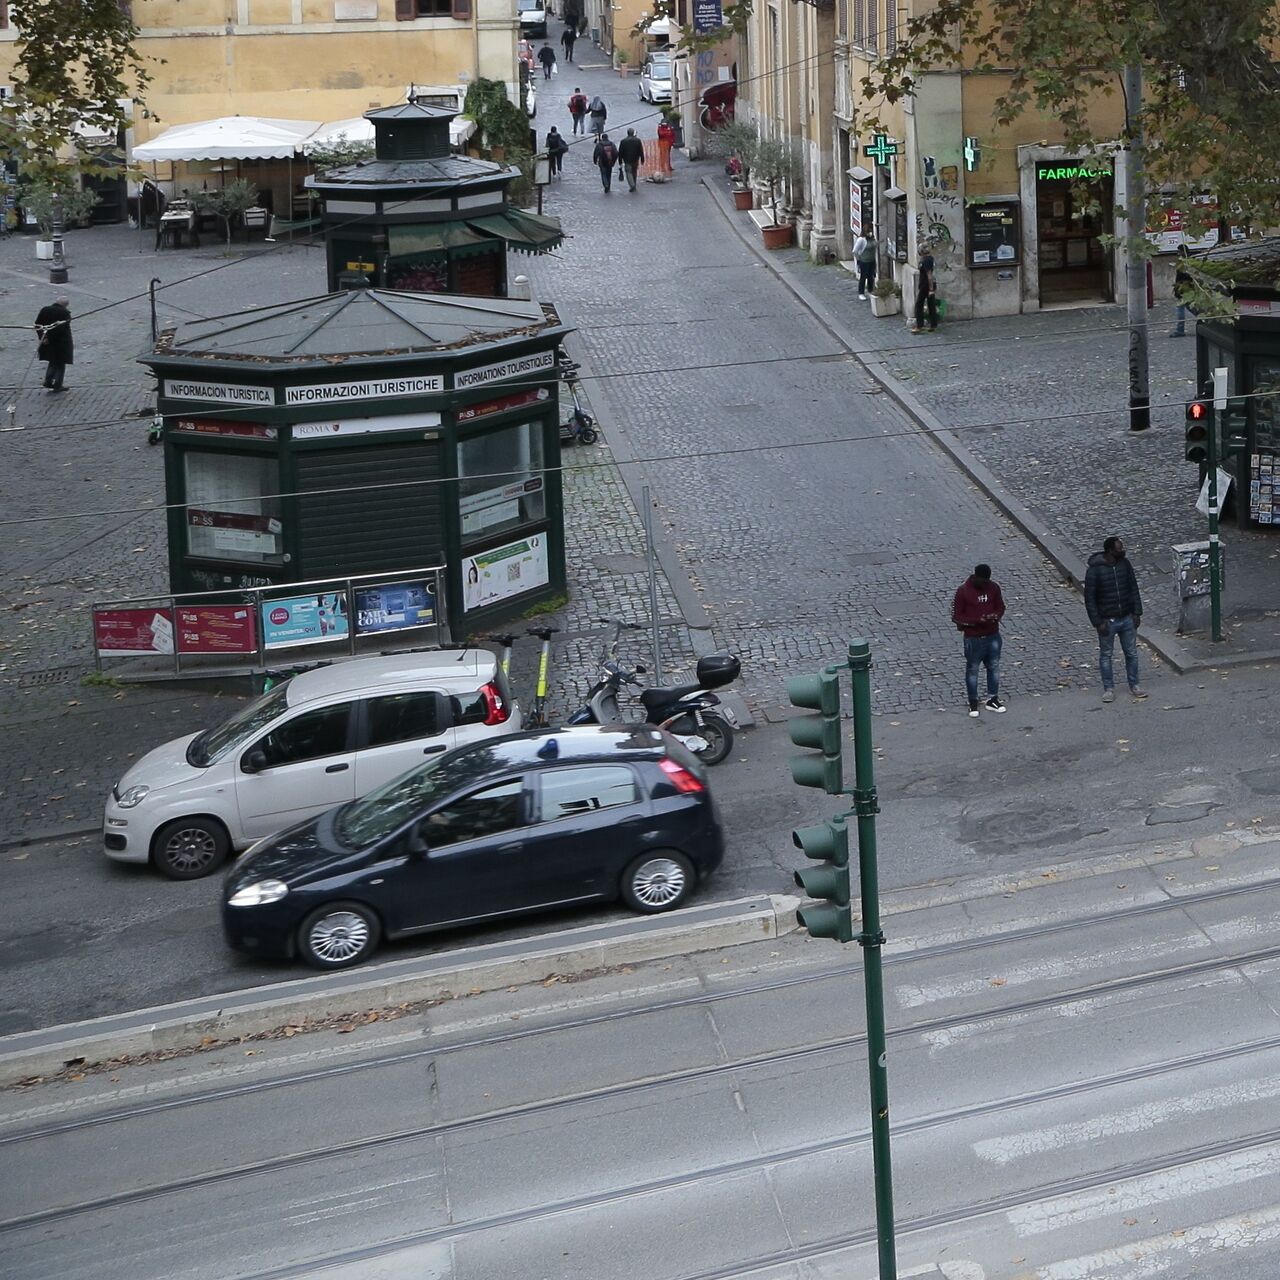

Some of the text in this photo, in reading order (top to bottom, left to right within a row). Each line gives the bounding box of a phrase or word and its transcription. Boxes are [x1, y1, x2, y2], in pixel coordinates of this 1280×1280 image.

[1038, 167, 1112, 181] FARMACA
[457, 353, 553, 388] INFORMATIONS TOURISTIQUES
[227, 388, 271, 402] TURISTICA
[287, 379, 439, 402] INFORMAZIONI TURISTICHE
[300, 424, 329, 435] ROMA
